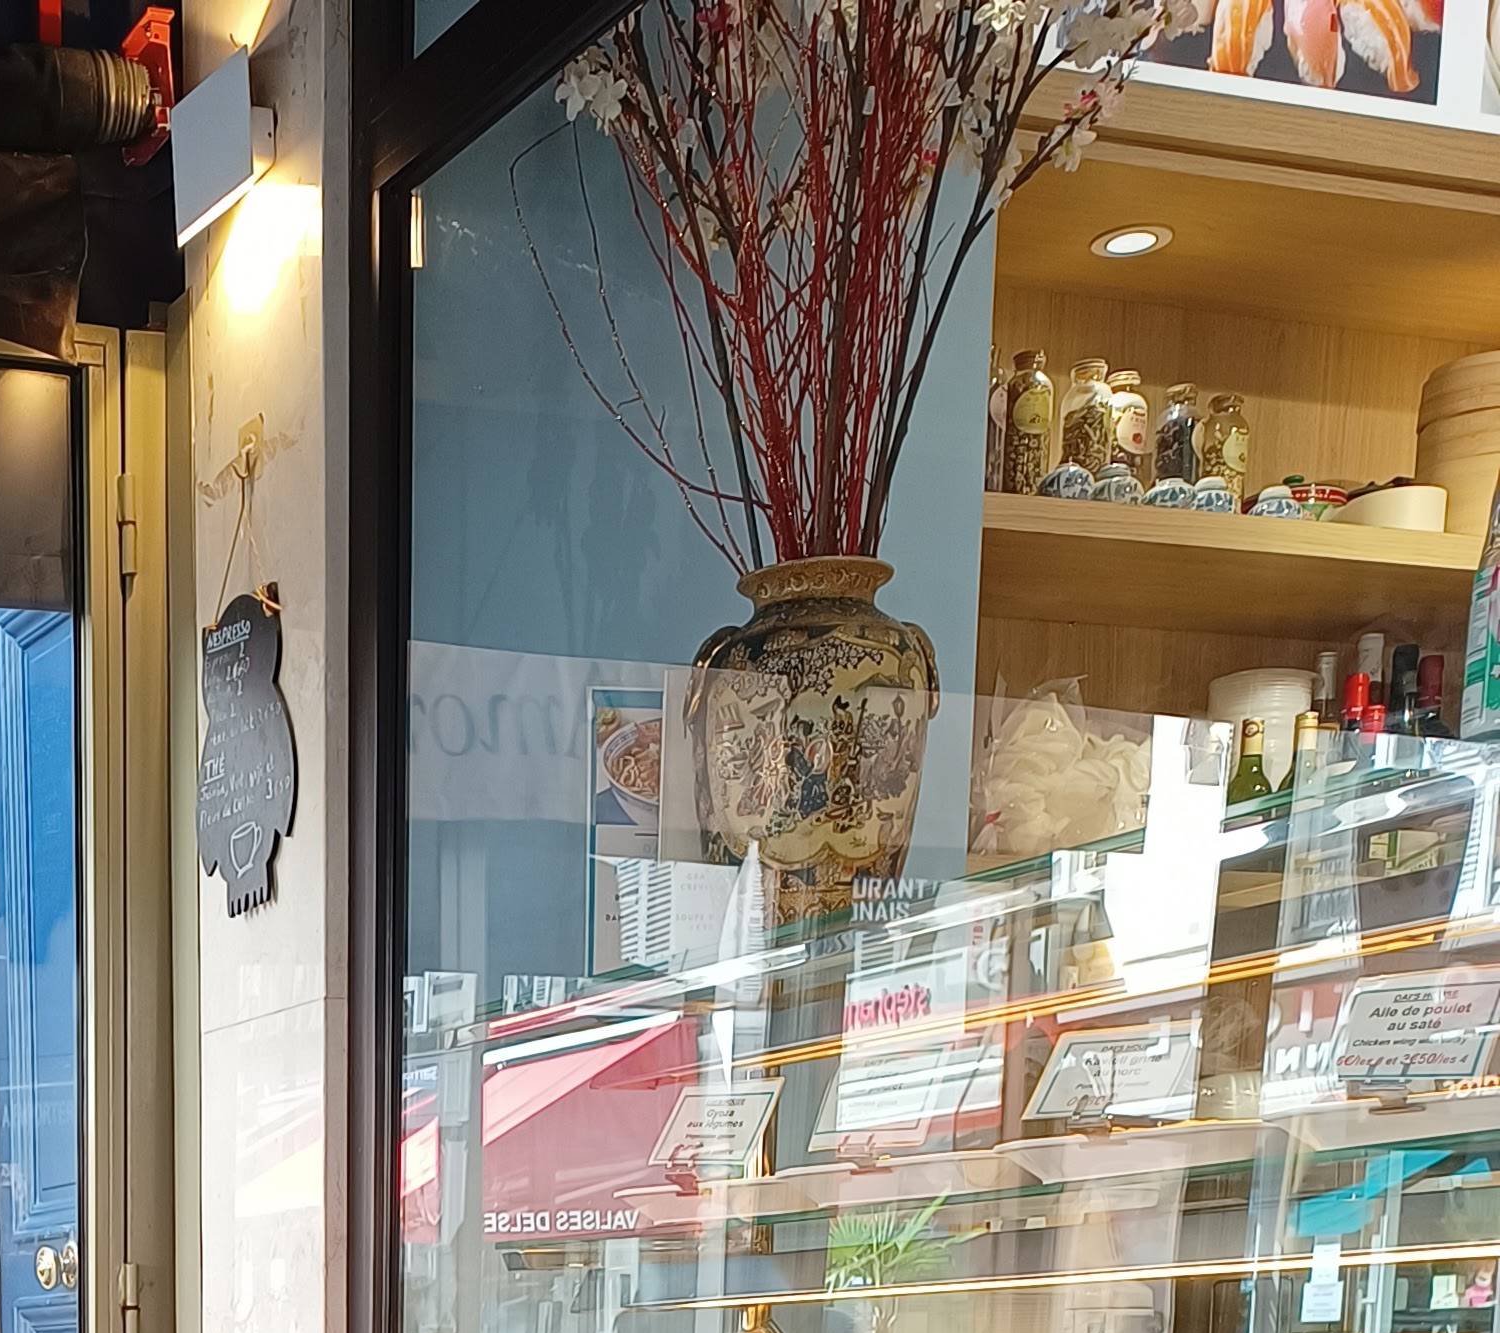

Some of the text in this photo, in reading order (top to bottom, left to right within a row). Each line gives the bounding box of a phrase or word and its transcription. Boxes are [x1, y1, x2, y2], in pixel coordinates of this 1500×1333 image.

[1402, 1005, 1420, 1016] de
[1423, 1002, 1472, 1017] poulet
[1387, 1022, 1405, 1031] au
